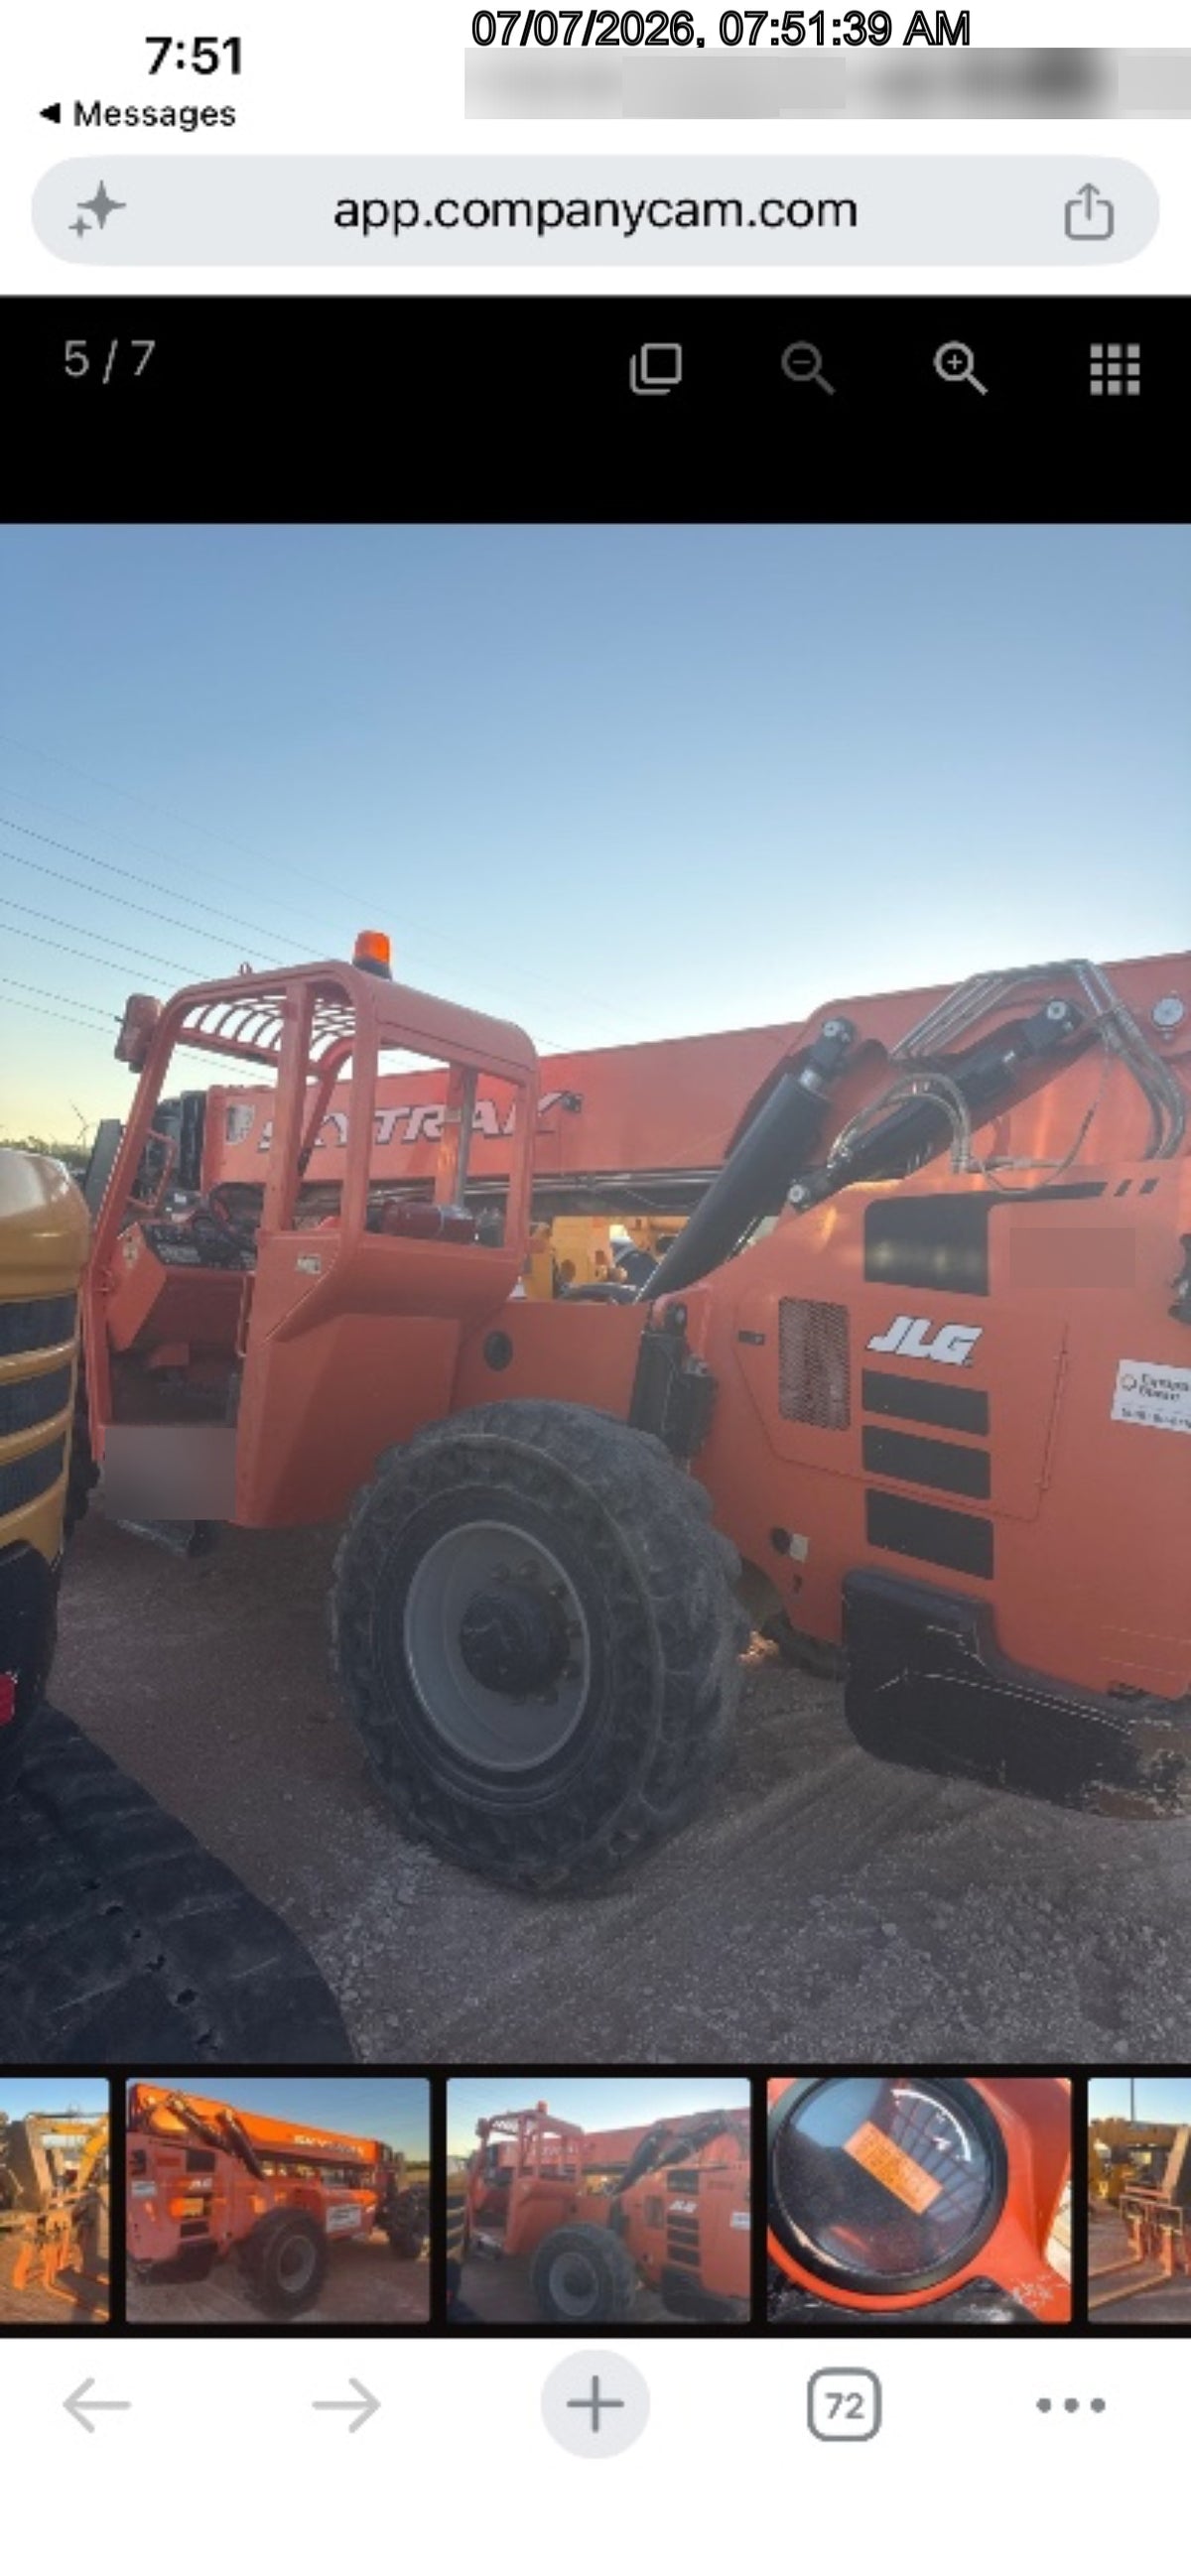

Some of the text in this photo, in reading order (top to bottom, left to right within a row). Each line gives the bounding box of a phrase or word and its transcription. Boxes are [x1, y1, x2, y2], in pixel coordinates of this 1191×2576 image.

[145, 36, 241, 75] 7:51
[74, 100, 236, 133] Messages
[333, 198, 858, 237] app.companycam.com
[65, 339, 156, 385] 5 / 7
[865, 1314, 983, 1366] JLG
[826, 2391, 864, 2419] 72
